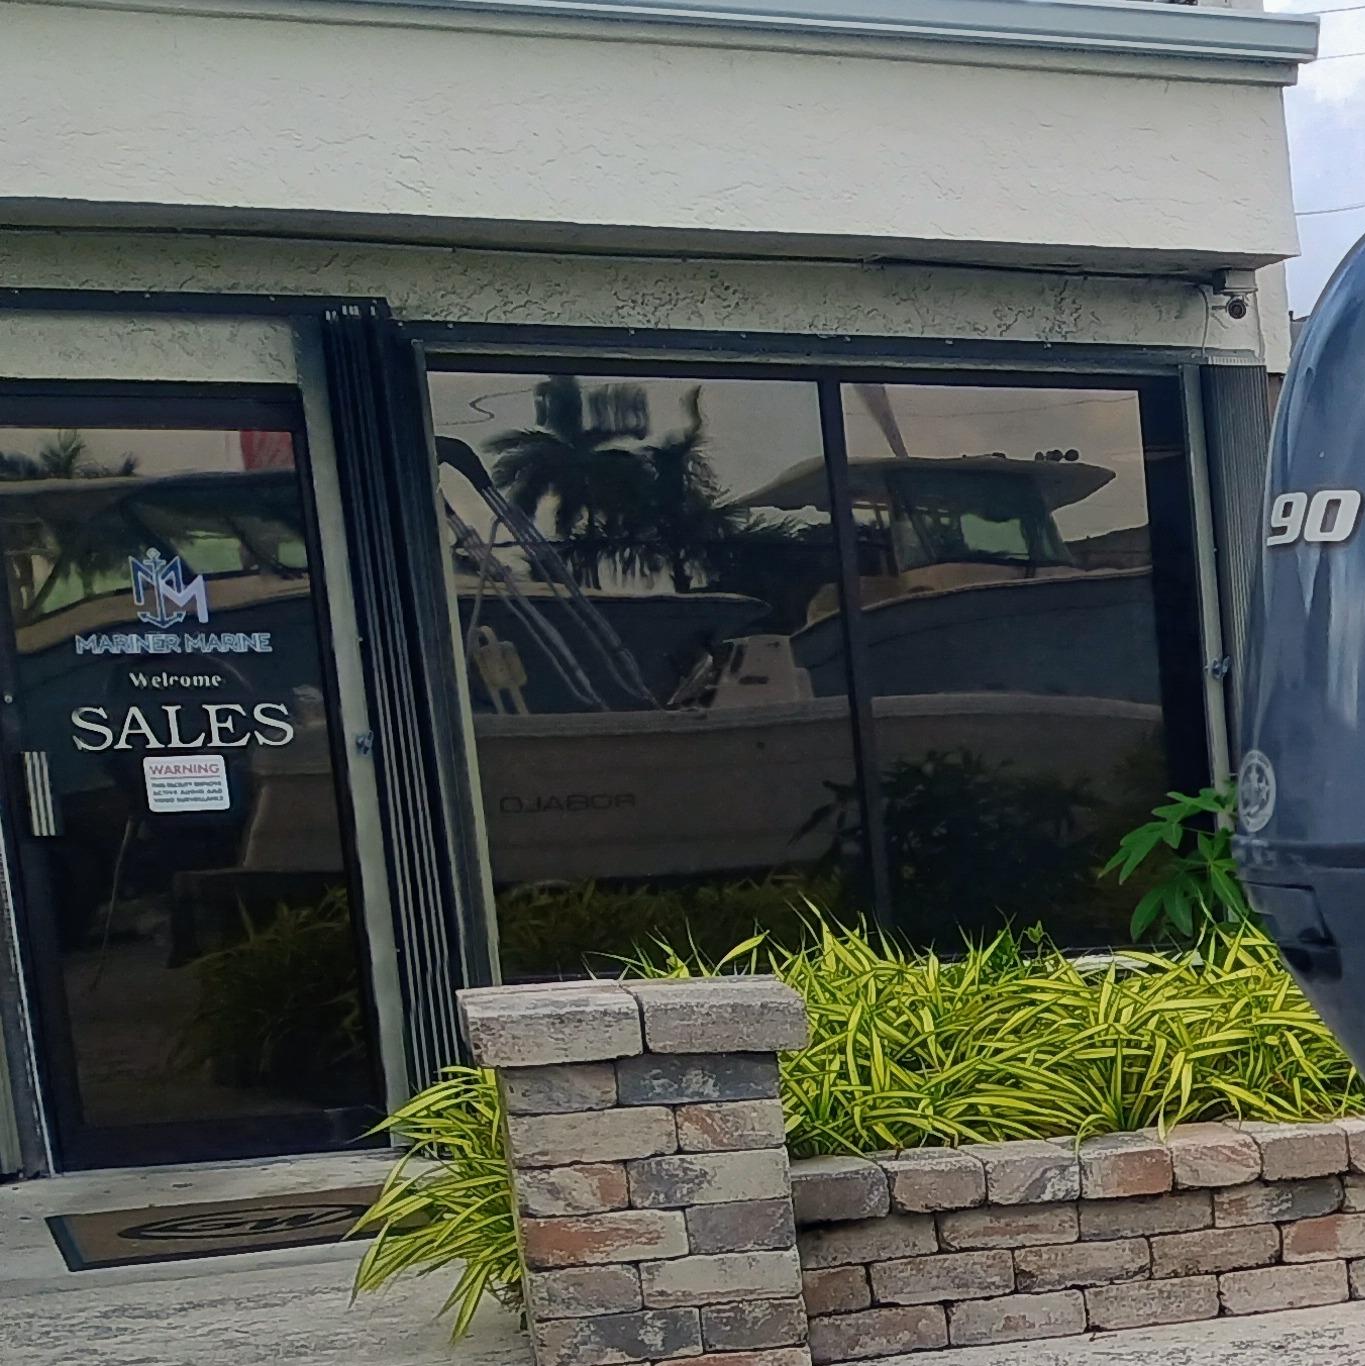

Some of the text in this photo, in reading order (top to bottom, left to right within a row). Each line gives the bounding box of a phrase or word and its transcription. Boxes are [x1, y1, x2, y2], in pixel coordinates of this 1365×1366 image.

[1266, 489, 1361, 546] 90
[75, 632, 273, 655] MARINER MARINE
[128, 671, 222, 689] Welcome
[71, 702, 295, 751] SALES
[149, 763, 220, 775] WARNING
